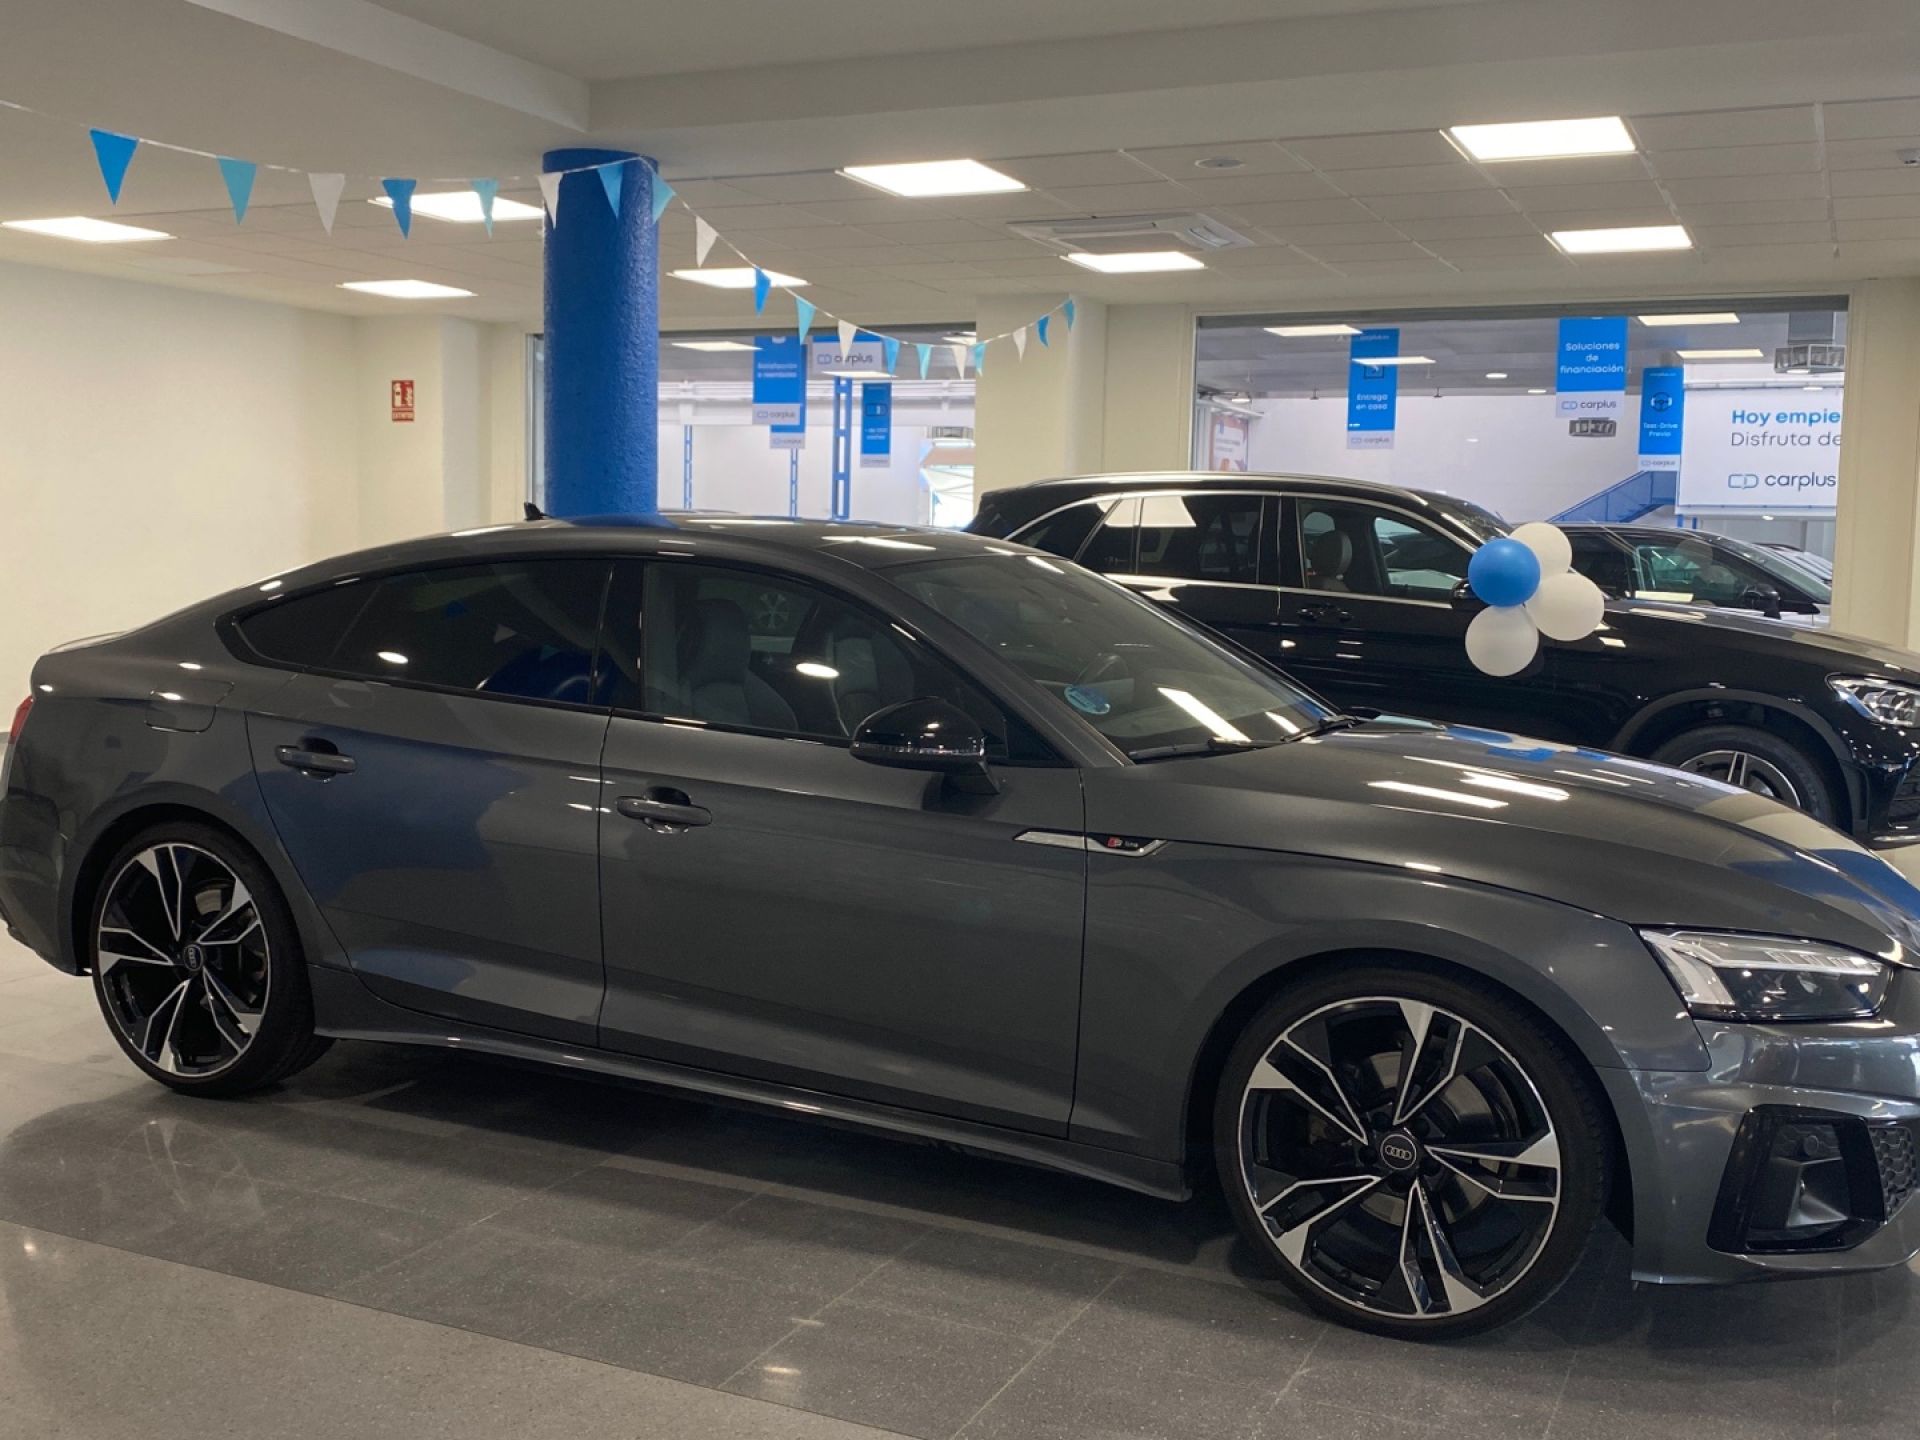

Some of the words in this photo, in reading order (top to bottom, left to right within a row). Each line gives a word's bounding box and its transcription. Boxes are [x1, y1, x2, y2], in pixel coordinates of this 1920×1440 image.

[1565, 342, 1620, 351] Soluciones
[1585, 353, 1599, 362] de
[1560, 364, 1623, 374] financiación
[1357, 393, 1388, 402] Entrega
[1580, 400, 1617, 411] carplus
[1732, 409, 1770, 427] Hoy
[1731, 431, 1811, 446] Disfruta
[1764, 472, 1836, 491] carplus
